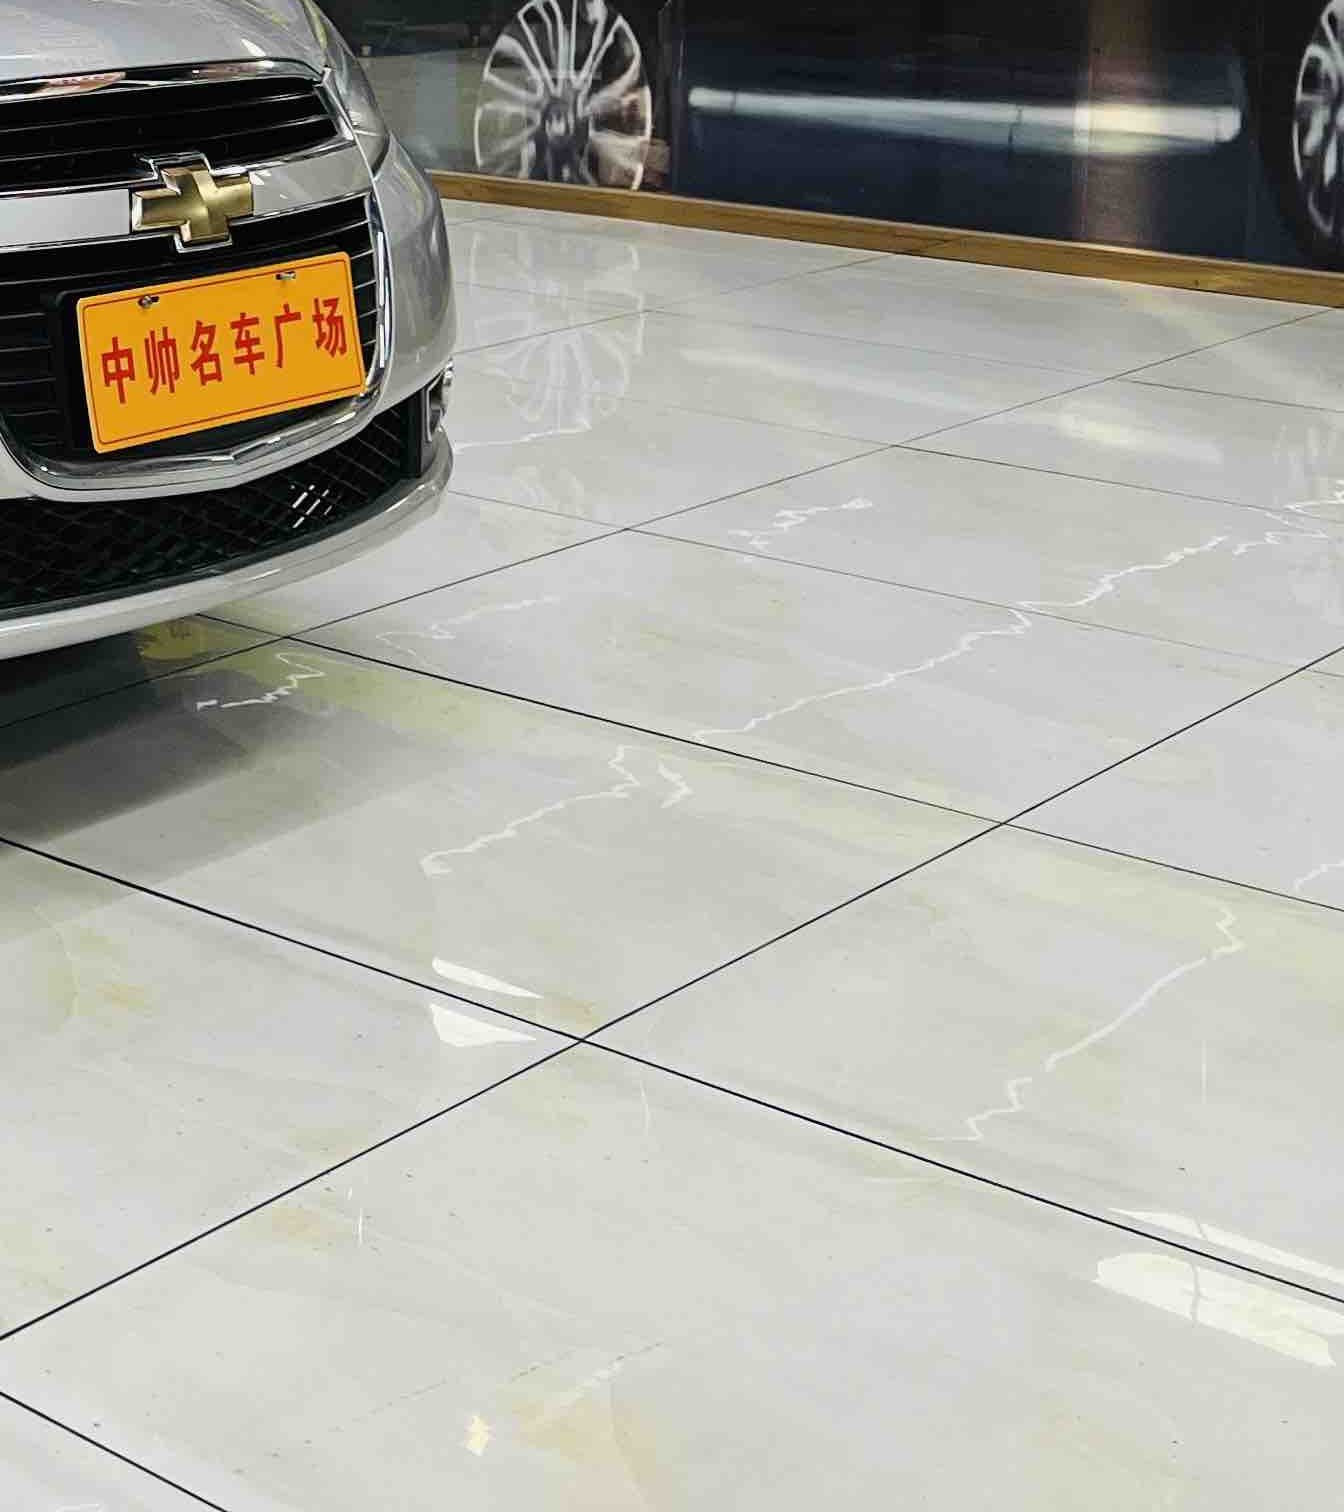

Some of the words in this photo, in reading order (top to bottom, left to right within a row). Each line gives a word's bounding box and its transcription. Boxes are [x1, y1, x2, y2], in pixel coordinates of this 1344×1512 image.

[100, 296, 348, 405] 中帅名车广场
